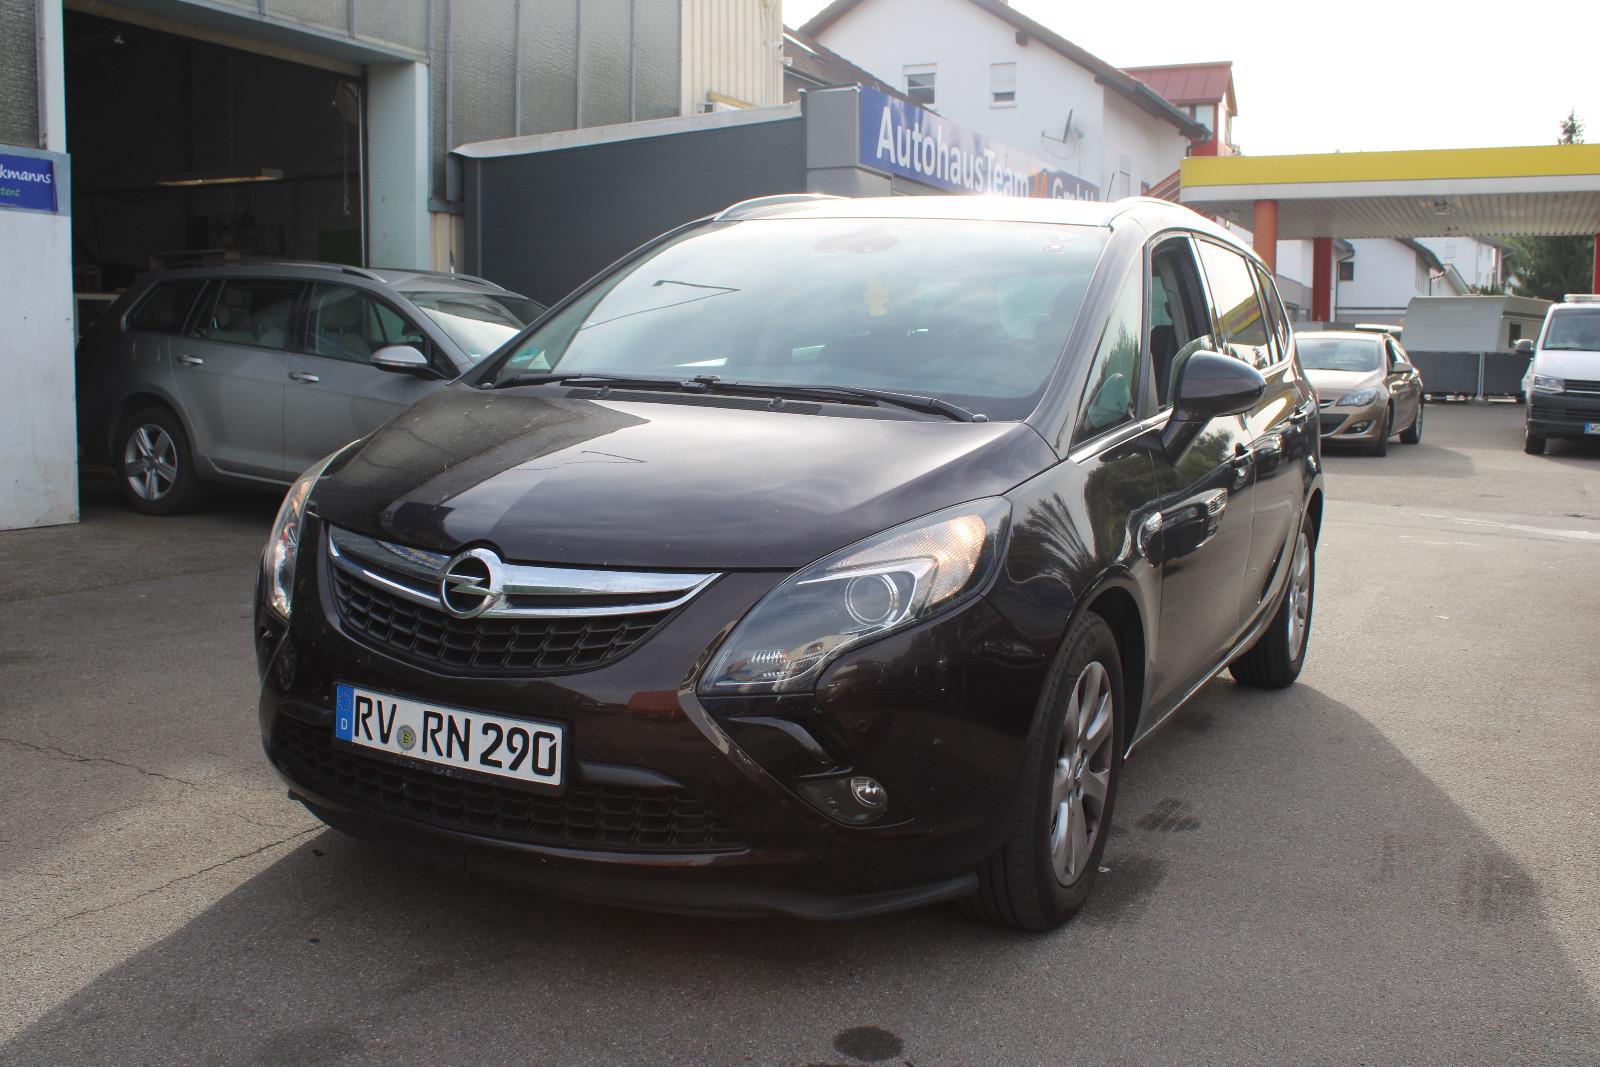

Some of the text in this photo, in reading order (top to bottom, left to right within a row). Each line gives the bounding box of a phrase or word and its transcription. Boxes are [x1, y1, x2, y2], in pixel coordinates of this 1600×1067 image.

[341, 718, 348, 730] D
[354, 695, 397, 744] RV
[422, 710, 471, 762] RN
[479, 722, 557, 777] 290
